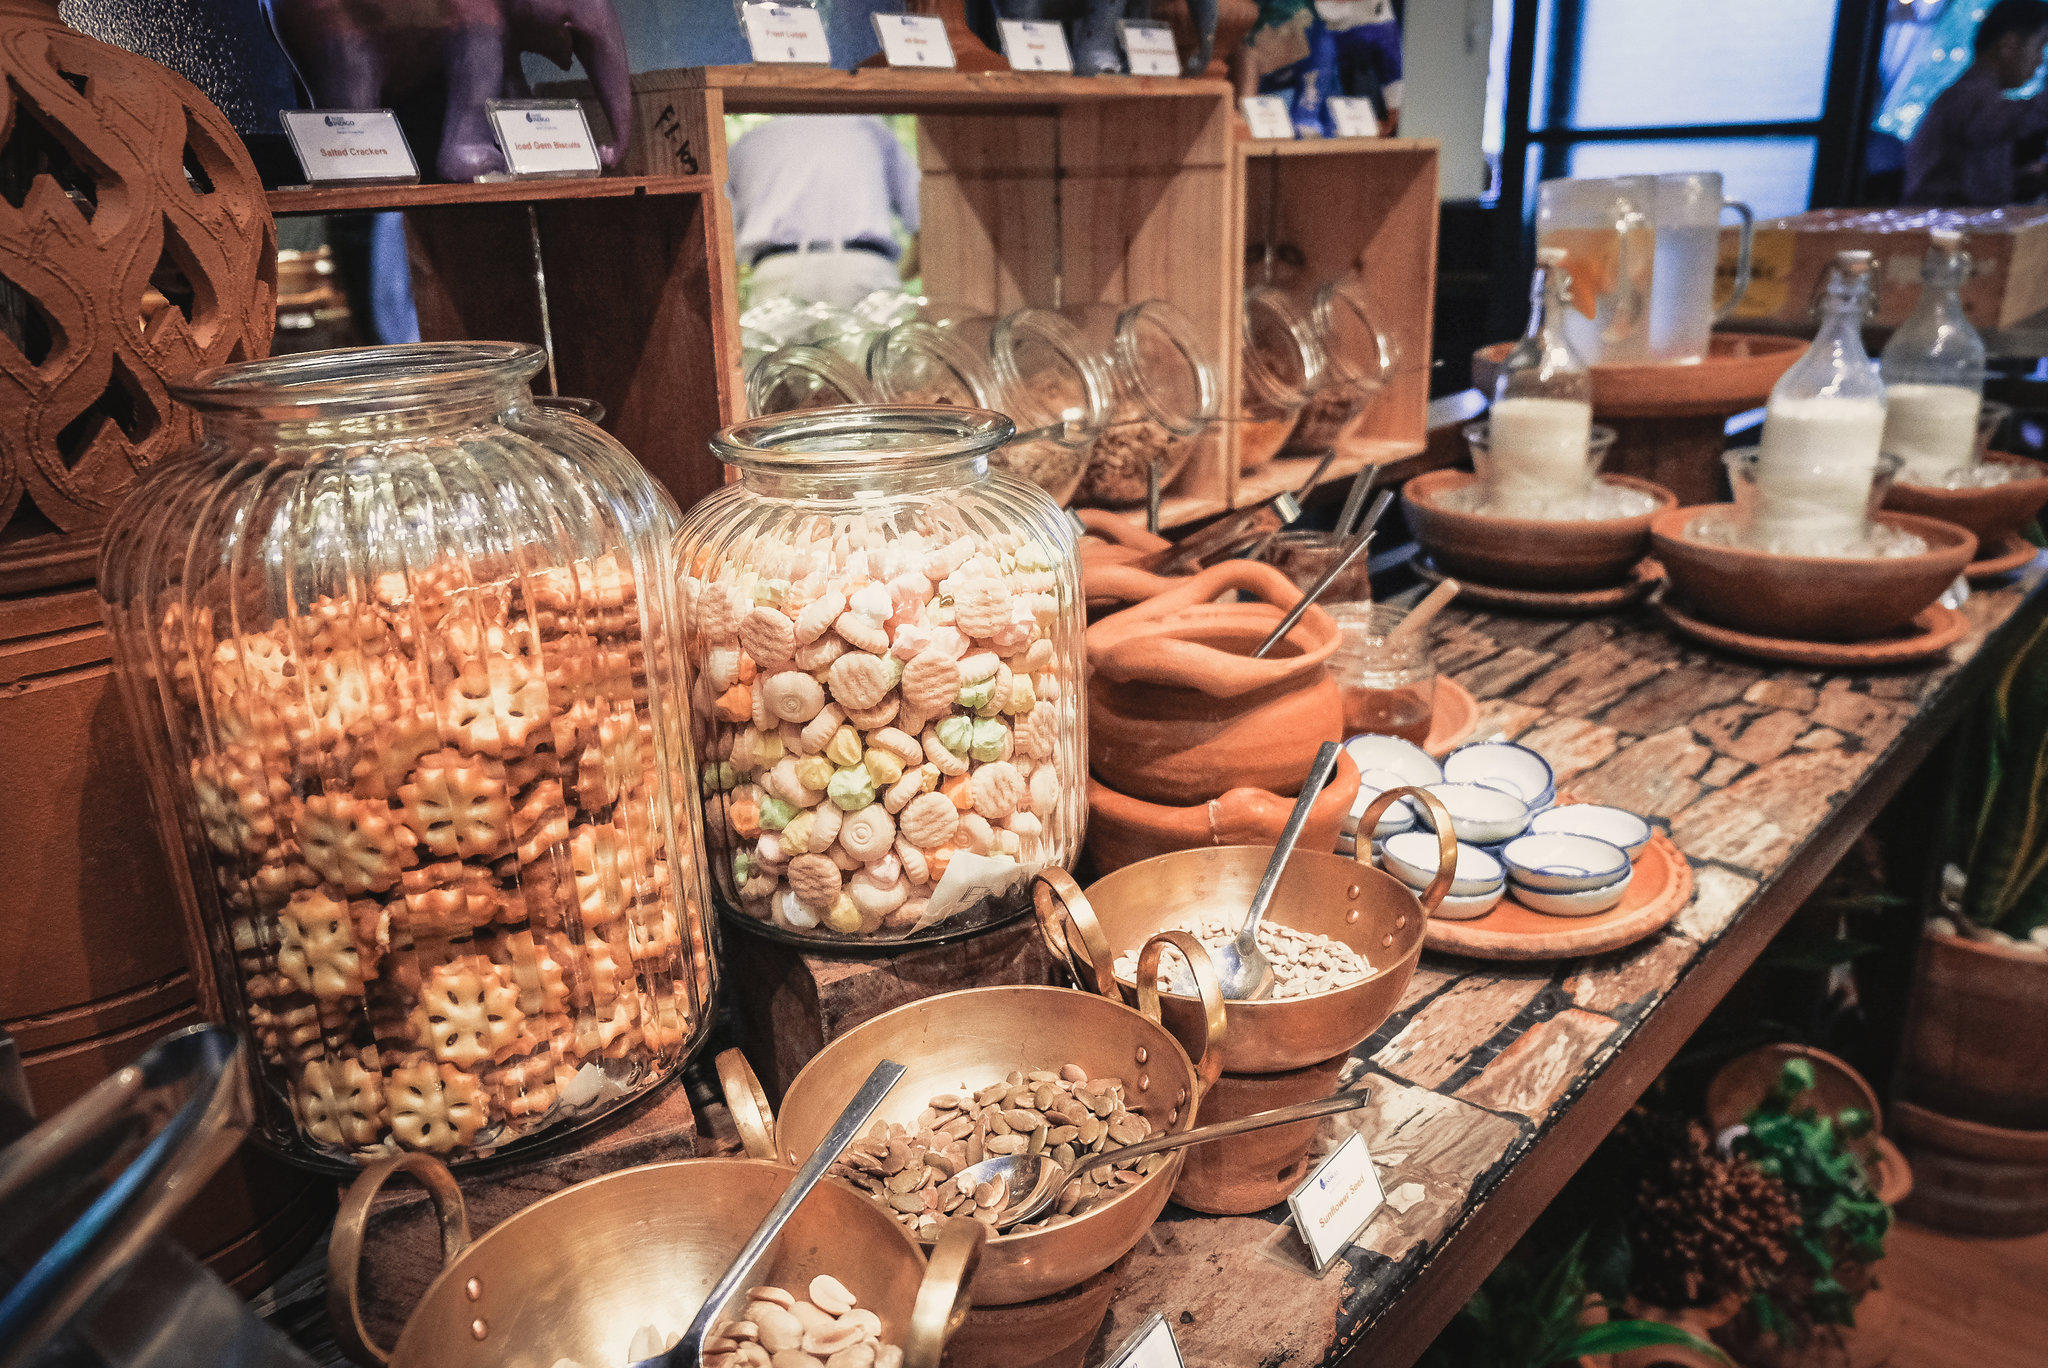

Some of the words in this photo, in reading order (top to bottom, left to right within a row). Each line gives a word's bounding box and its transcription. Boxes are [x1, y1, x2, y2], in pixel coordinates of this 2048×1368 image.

[320, 147, 348, 157] Salted
[349, 146, 388, 156] Crackers
[515, 141, 532, 151] Iced
[533, 141, 553, 150] Gem
[553, 141, 581, 150] Biscuits
[1319, 1192, 1350, 1229] Sunflower
[1348, 1175, 1365, 1196] Seed
